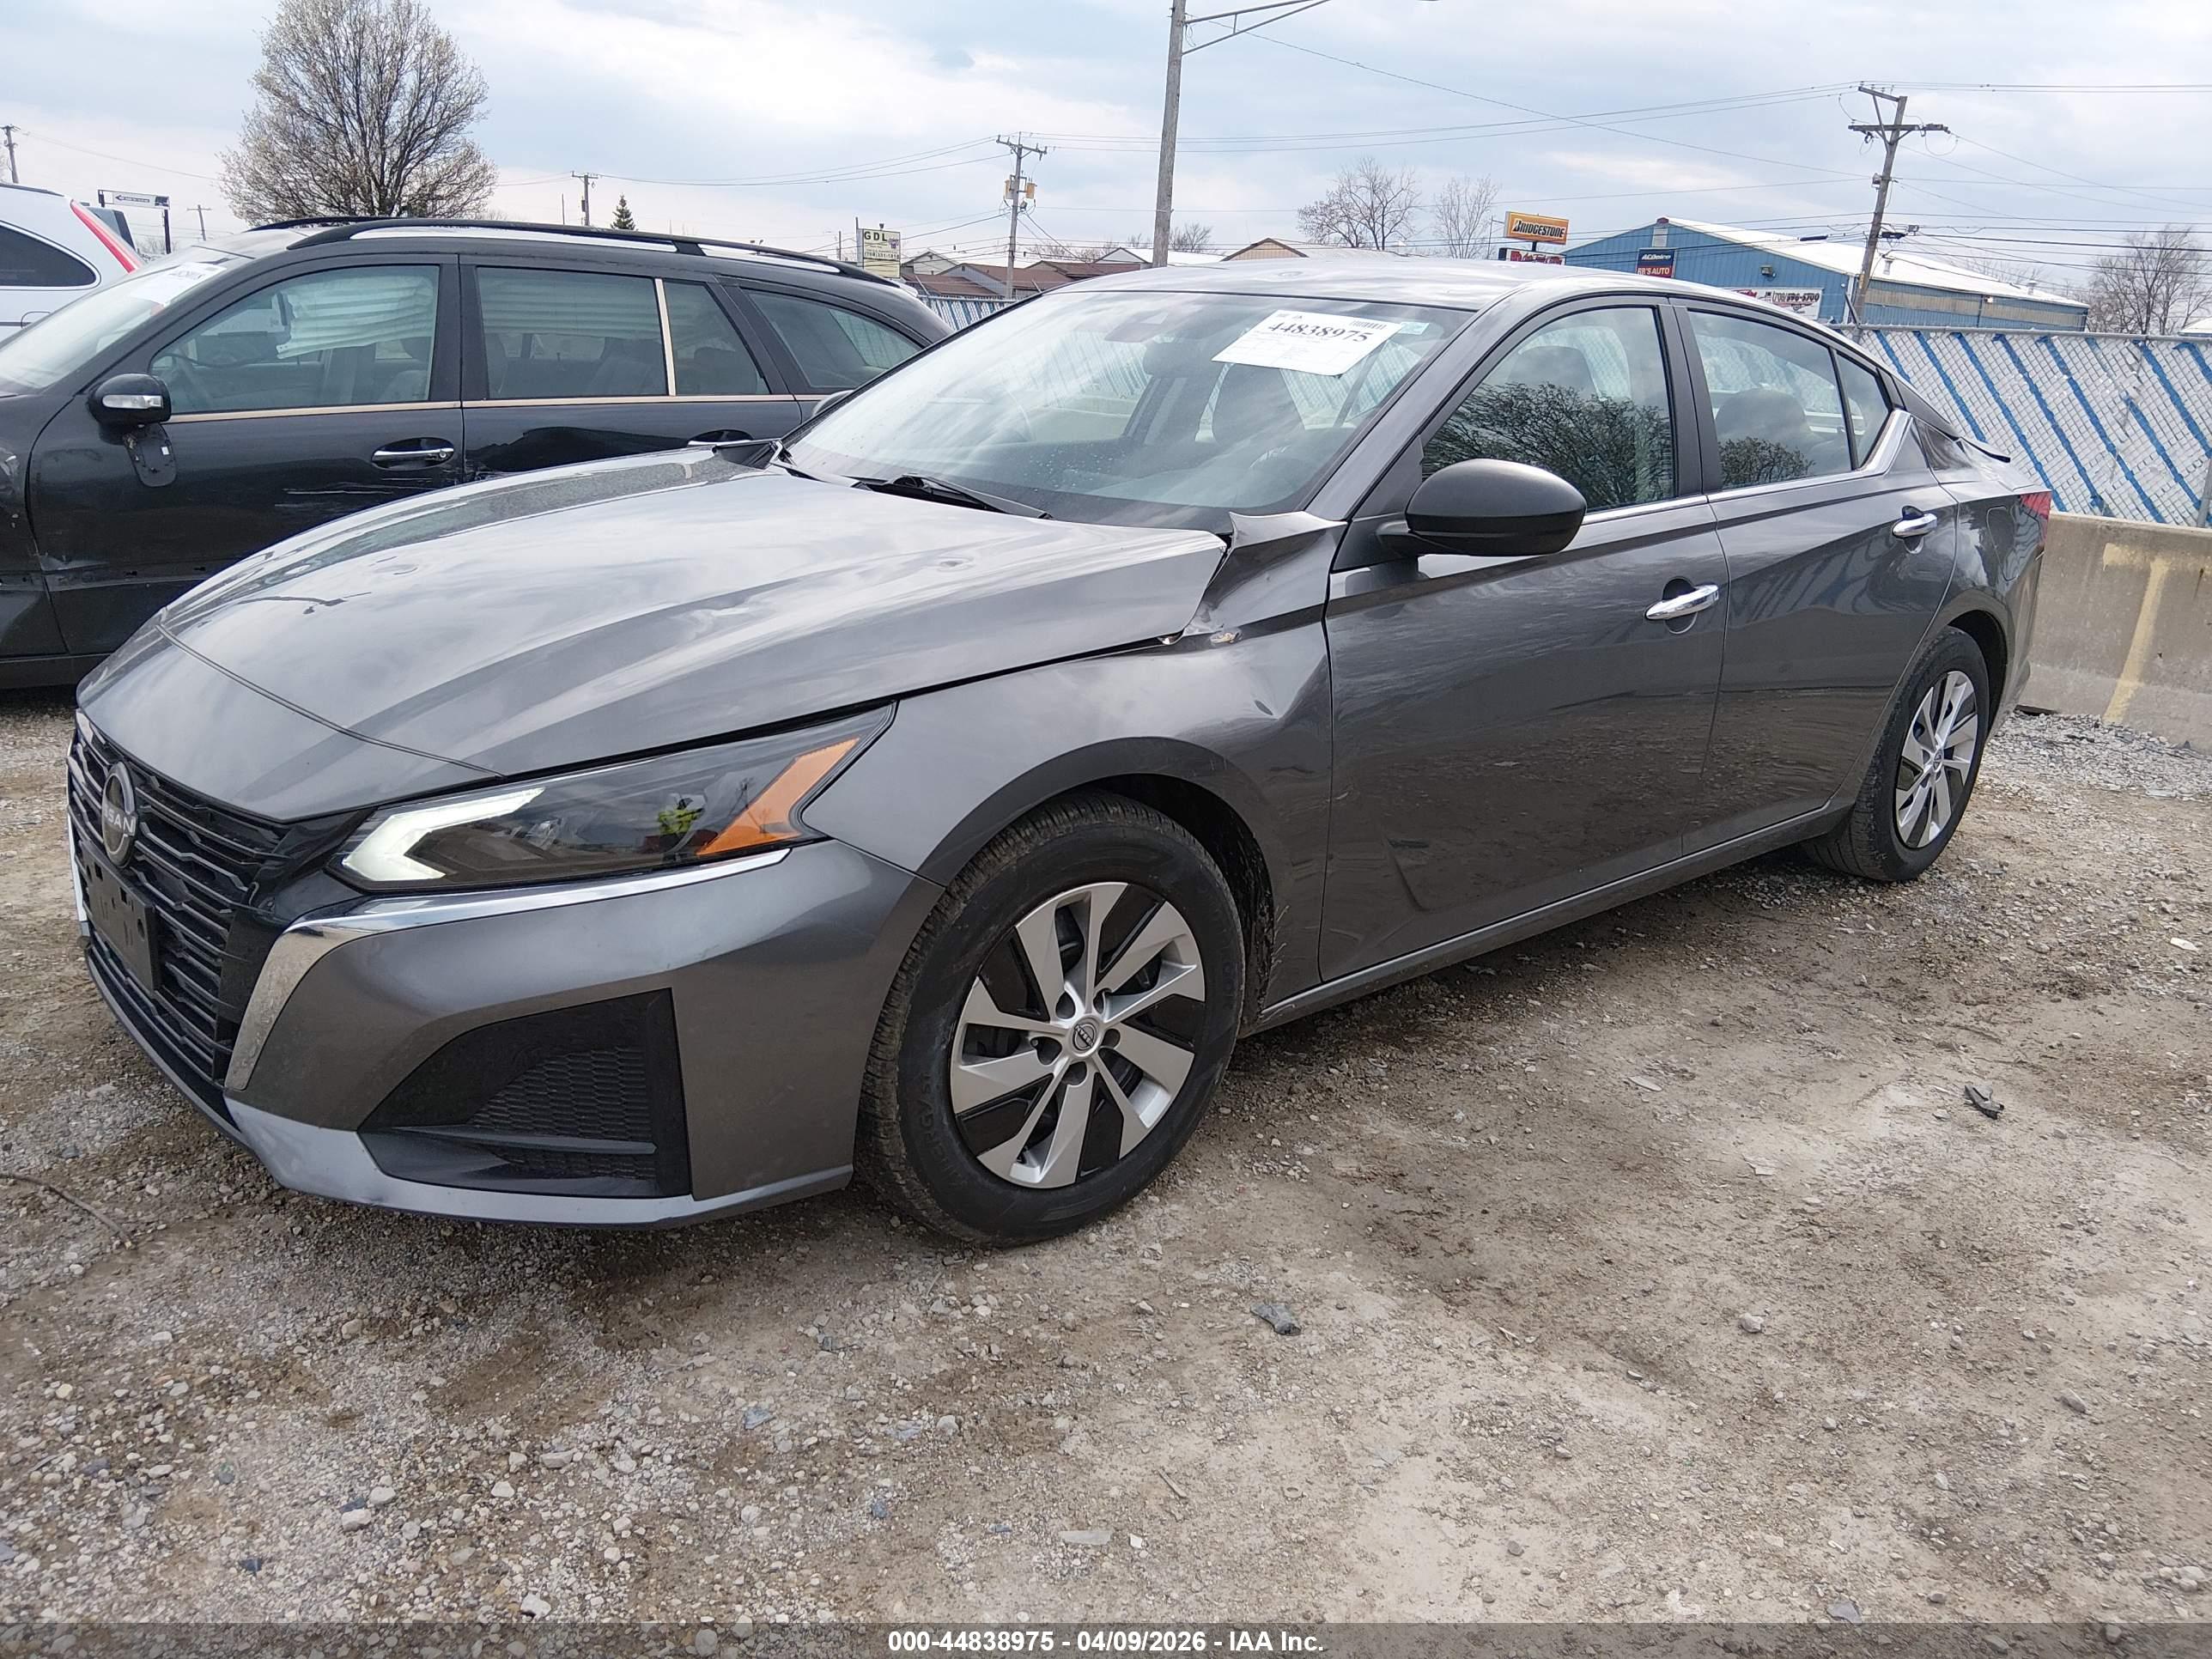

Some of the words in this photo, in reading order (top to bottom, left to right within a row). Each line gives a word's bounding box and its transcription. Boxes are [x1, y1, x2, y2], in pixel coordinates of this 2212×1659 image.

[864, 231, 887, 241] GDL
[1512, 220, 1565, 238] BRIDGESTONE
[1268, 322, 1373, 342] 44838975
